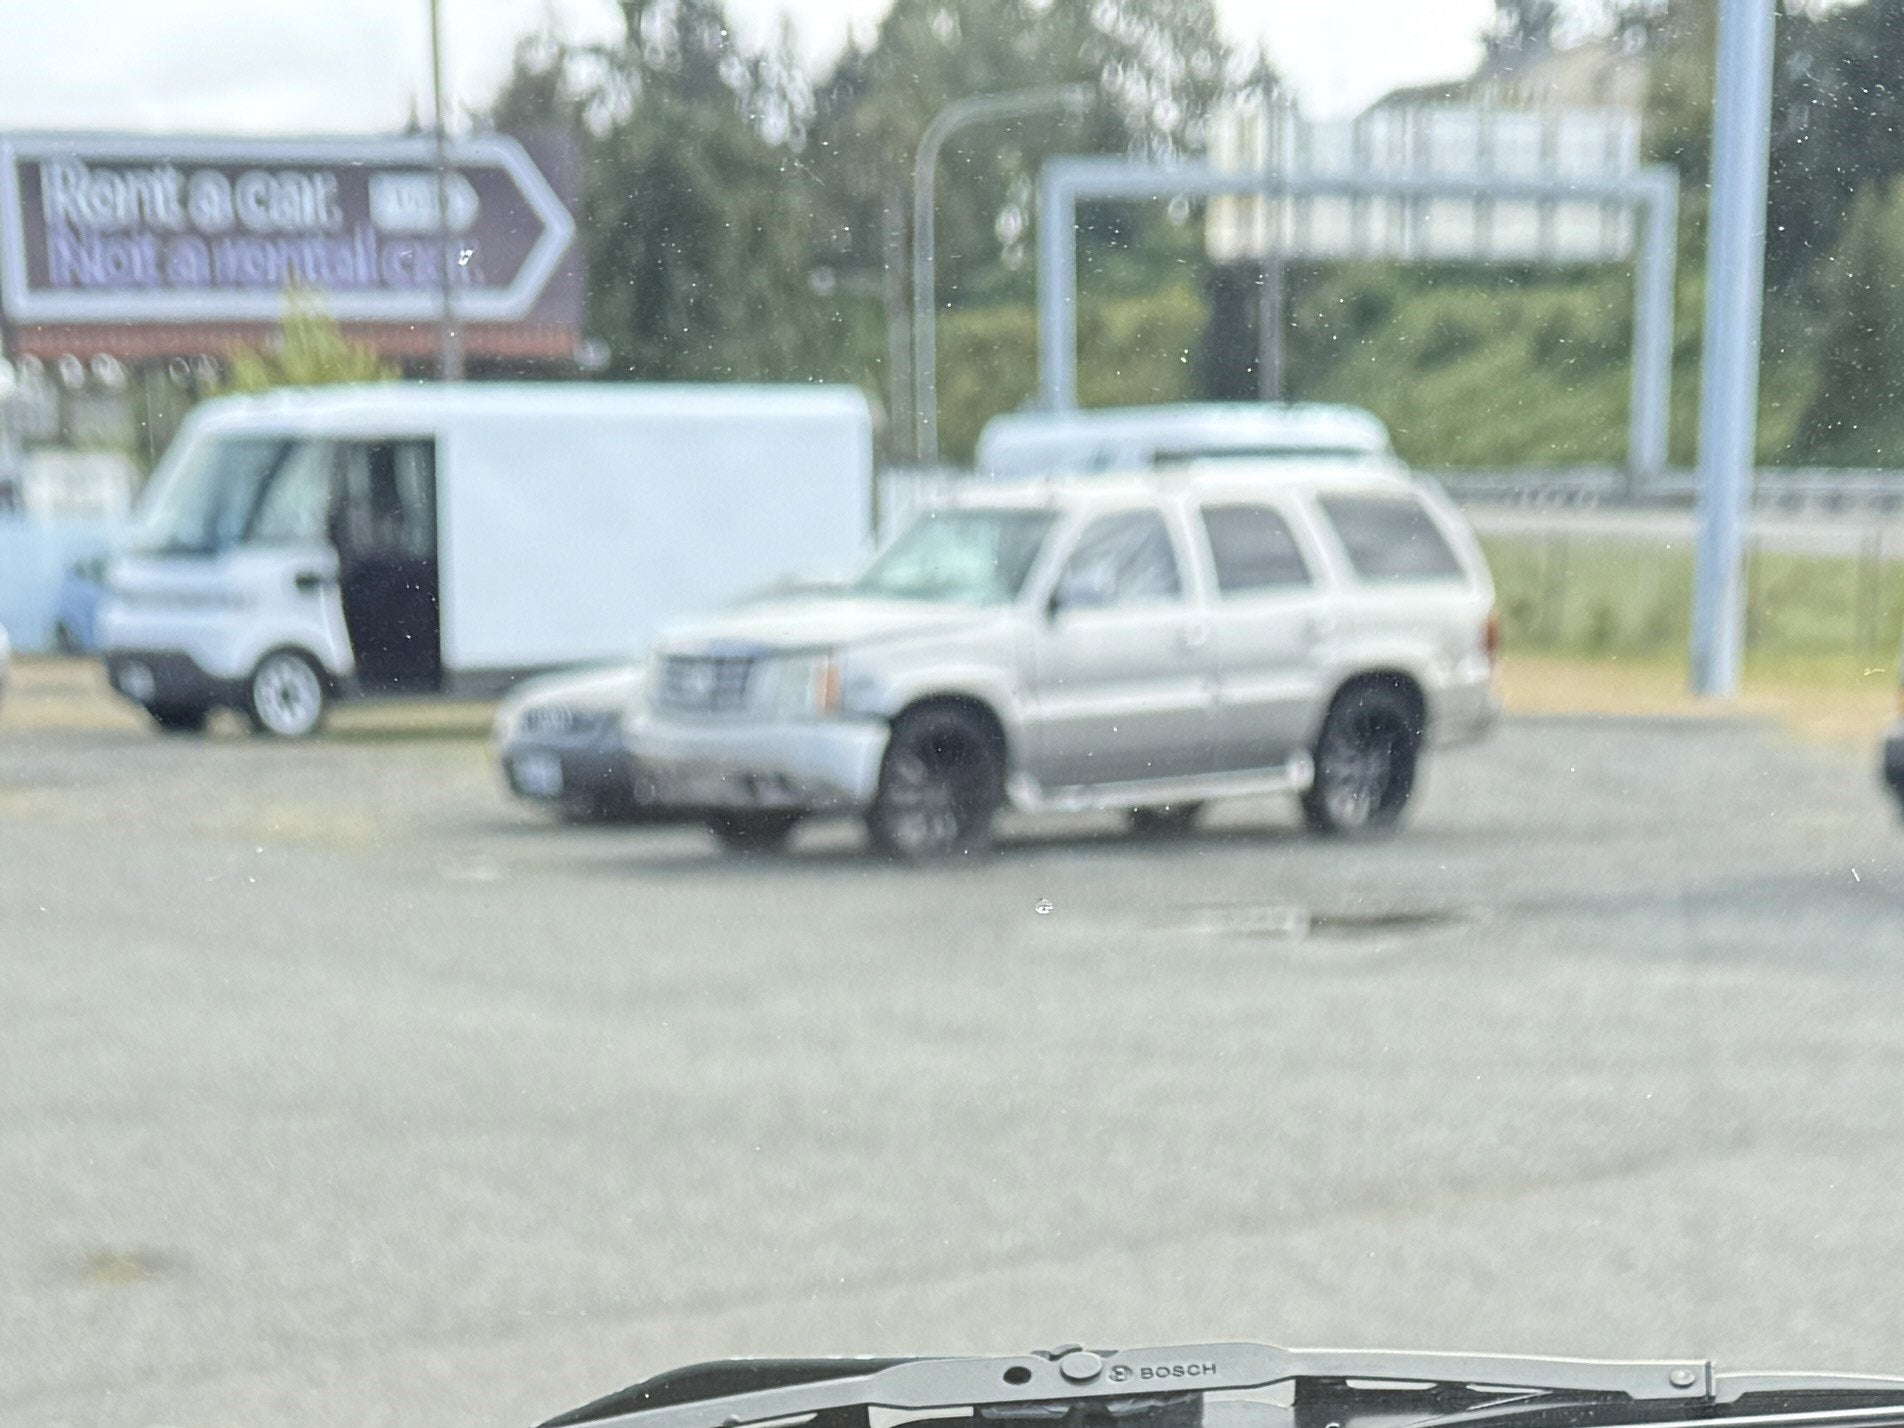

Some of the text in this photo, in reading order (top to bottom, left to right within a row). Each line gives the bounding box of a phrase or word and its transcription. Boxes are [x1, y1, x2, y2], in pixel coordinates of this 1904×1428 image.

[43, 158, 184, 226] Rent
[188, 172, 231, 229] a
[50, 228, 158, 284] Not
[165, 238, 211, 284] a
[216, 222, 377, 284] rental
[1140, 1362, 1217, 1380] BOSCH
